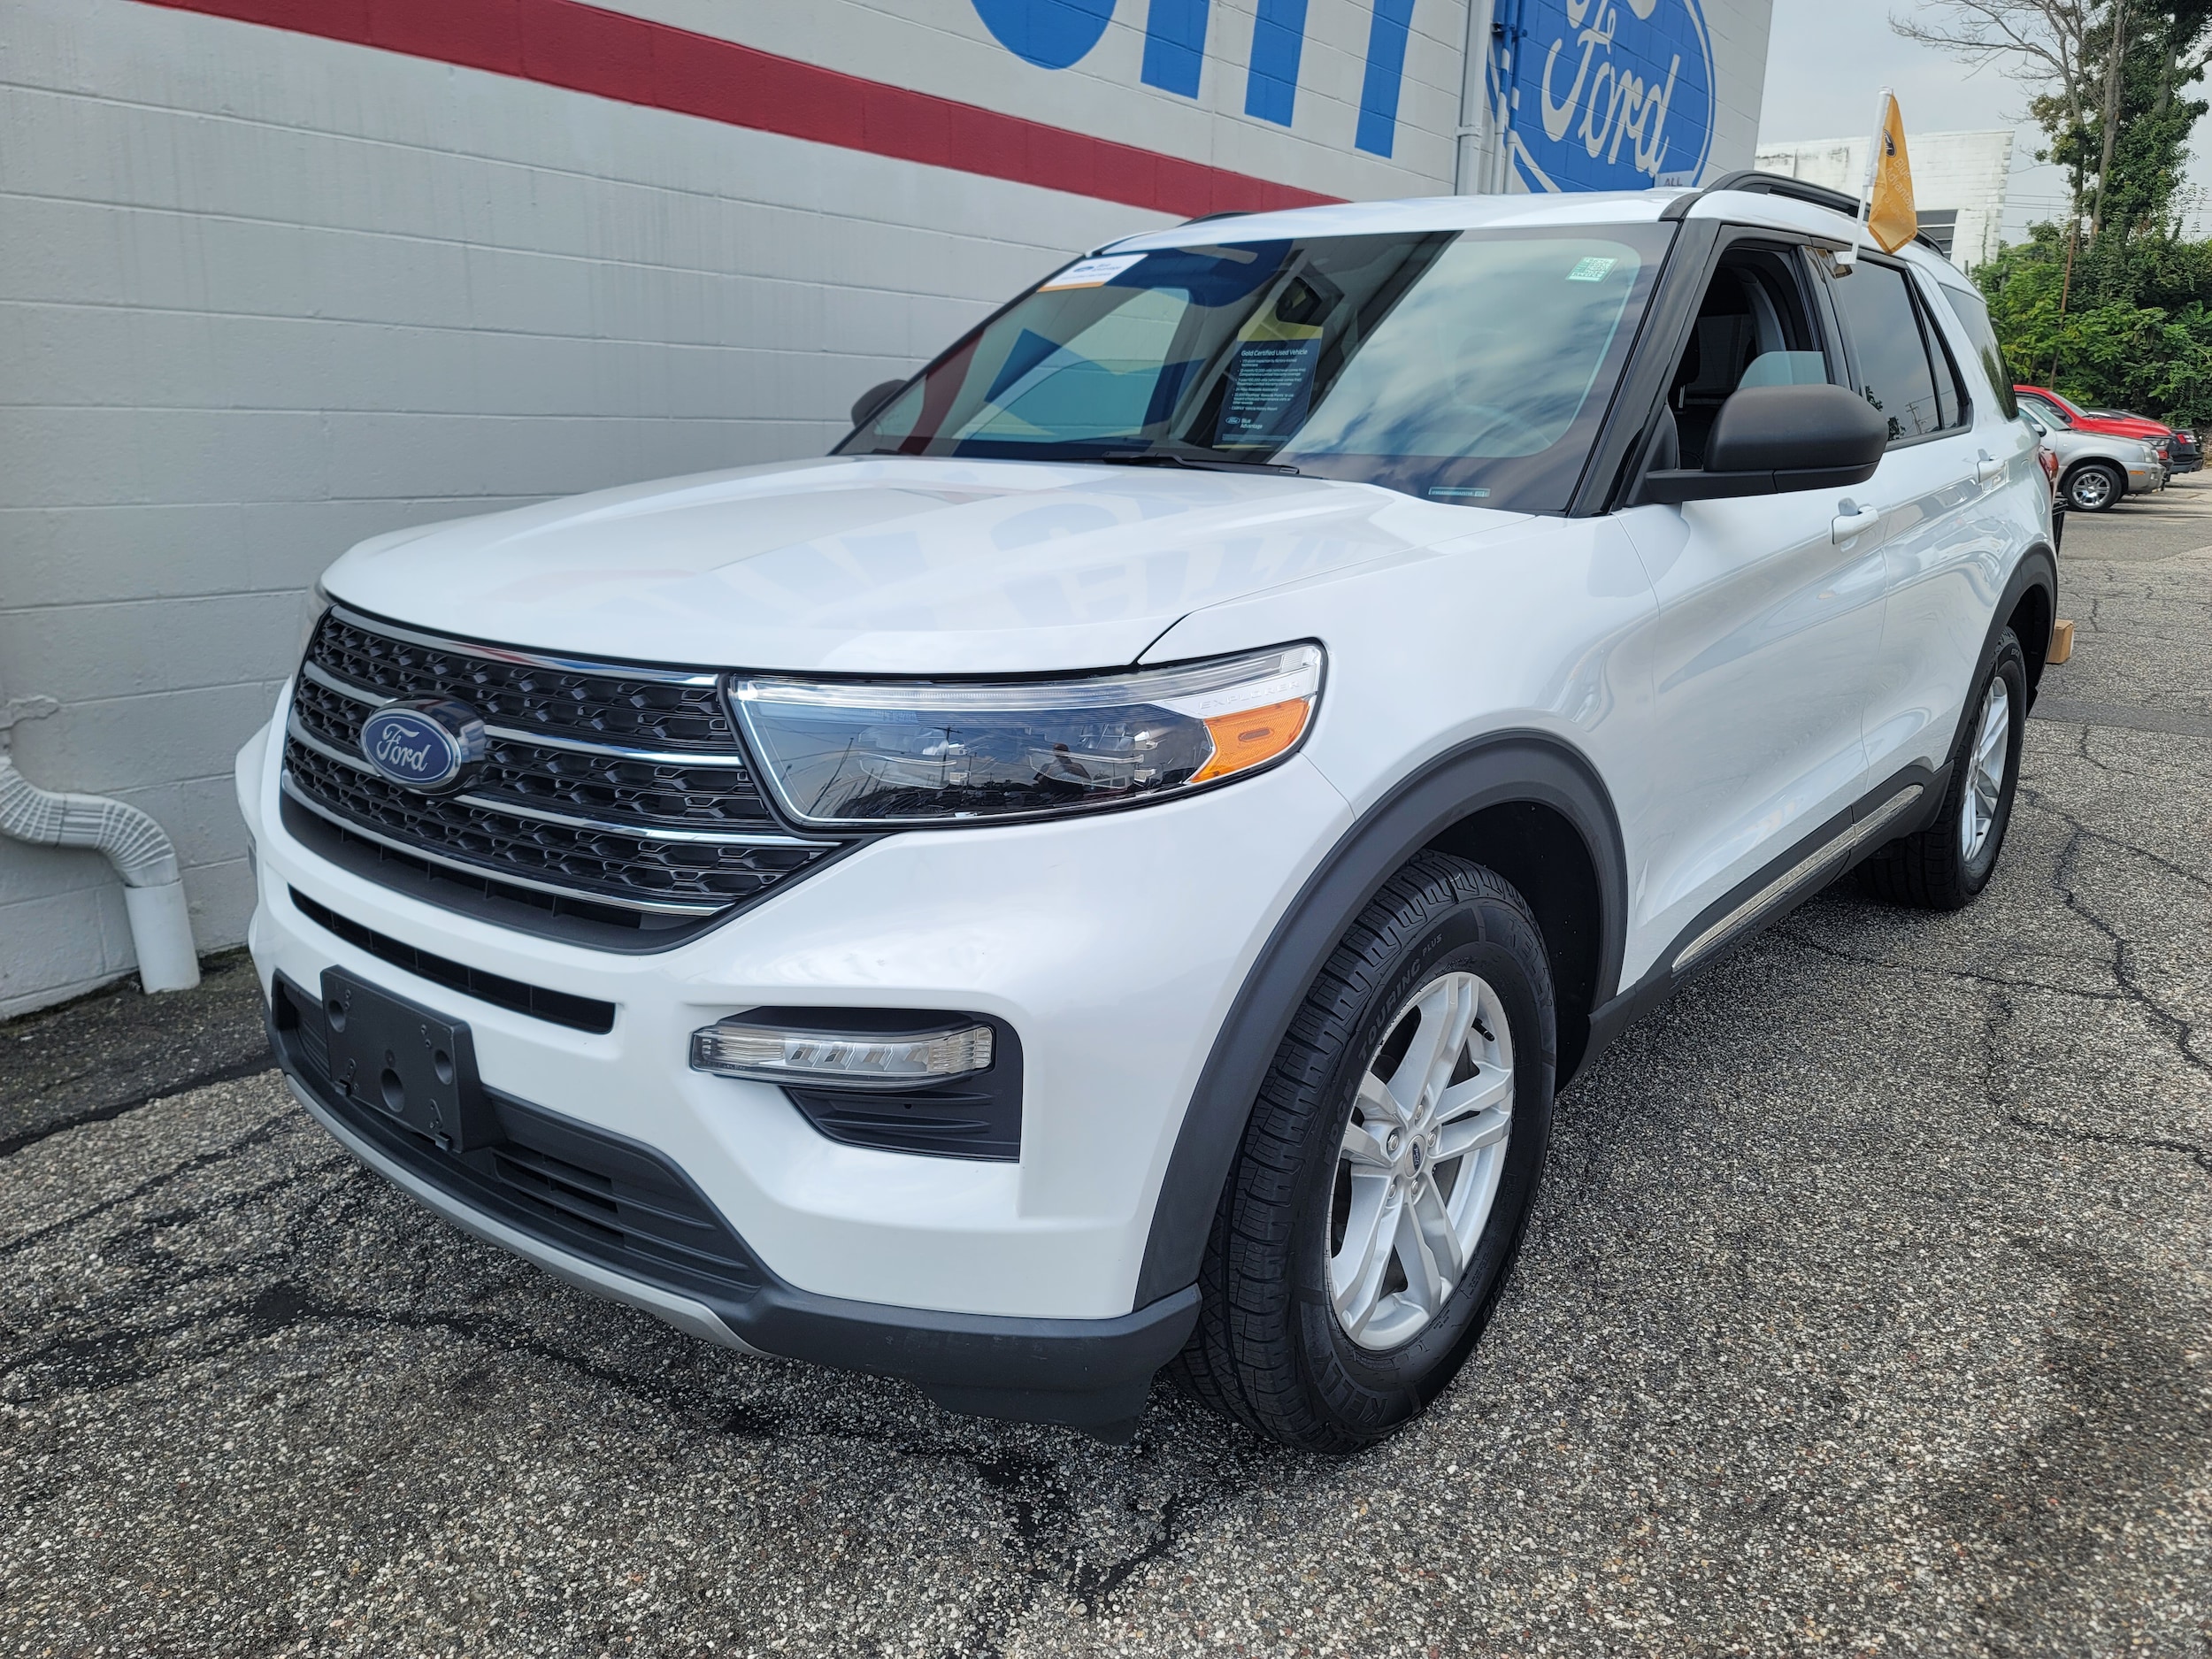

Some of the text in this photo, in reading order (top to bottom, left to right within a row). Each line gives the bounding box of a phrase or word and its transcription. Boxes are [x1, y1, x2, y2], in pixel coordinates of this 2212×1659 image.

[1541, 0, 1680, 177] Ford
[1893, 157, 1911, 180] Blue
[1199, 681, 1300, 709] EXPLORER
[376, 723, 432, 772] Ford
[1358, 958, 1422, 1062] TOURING
[1421, 933, 1443, 957] PLUS
